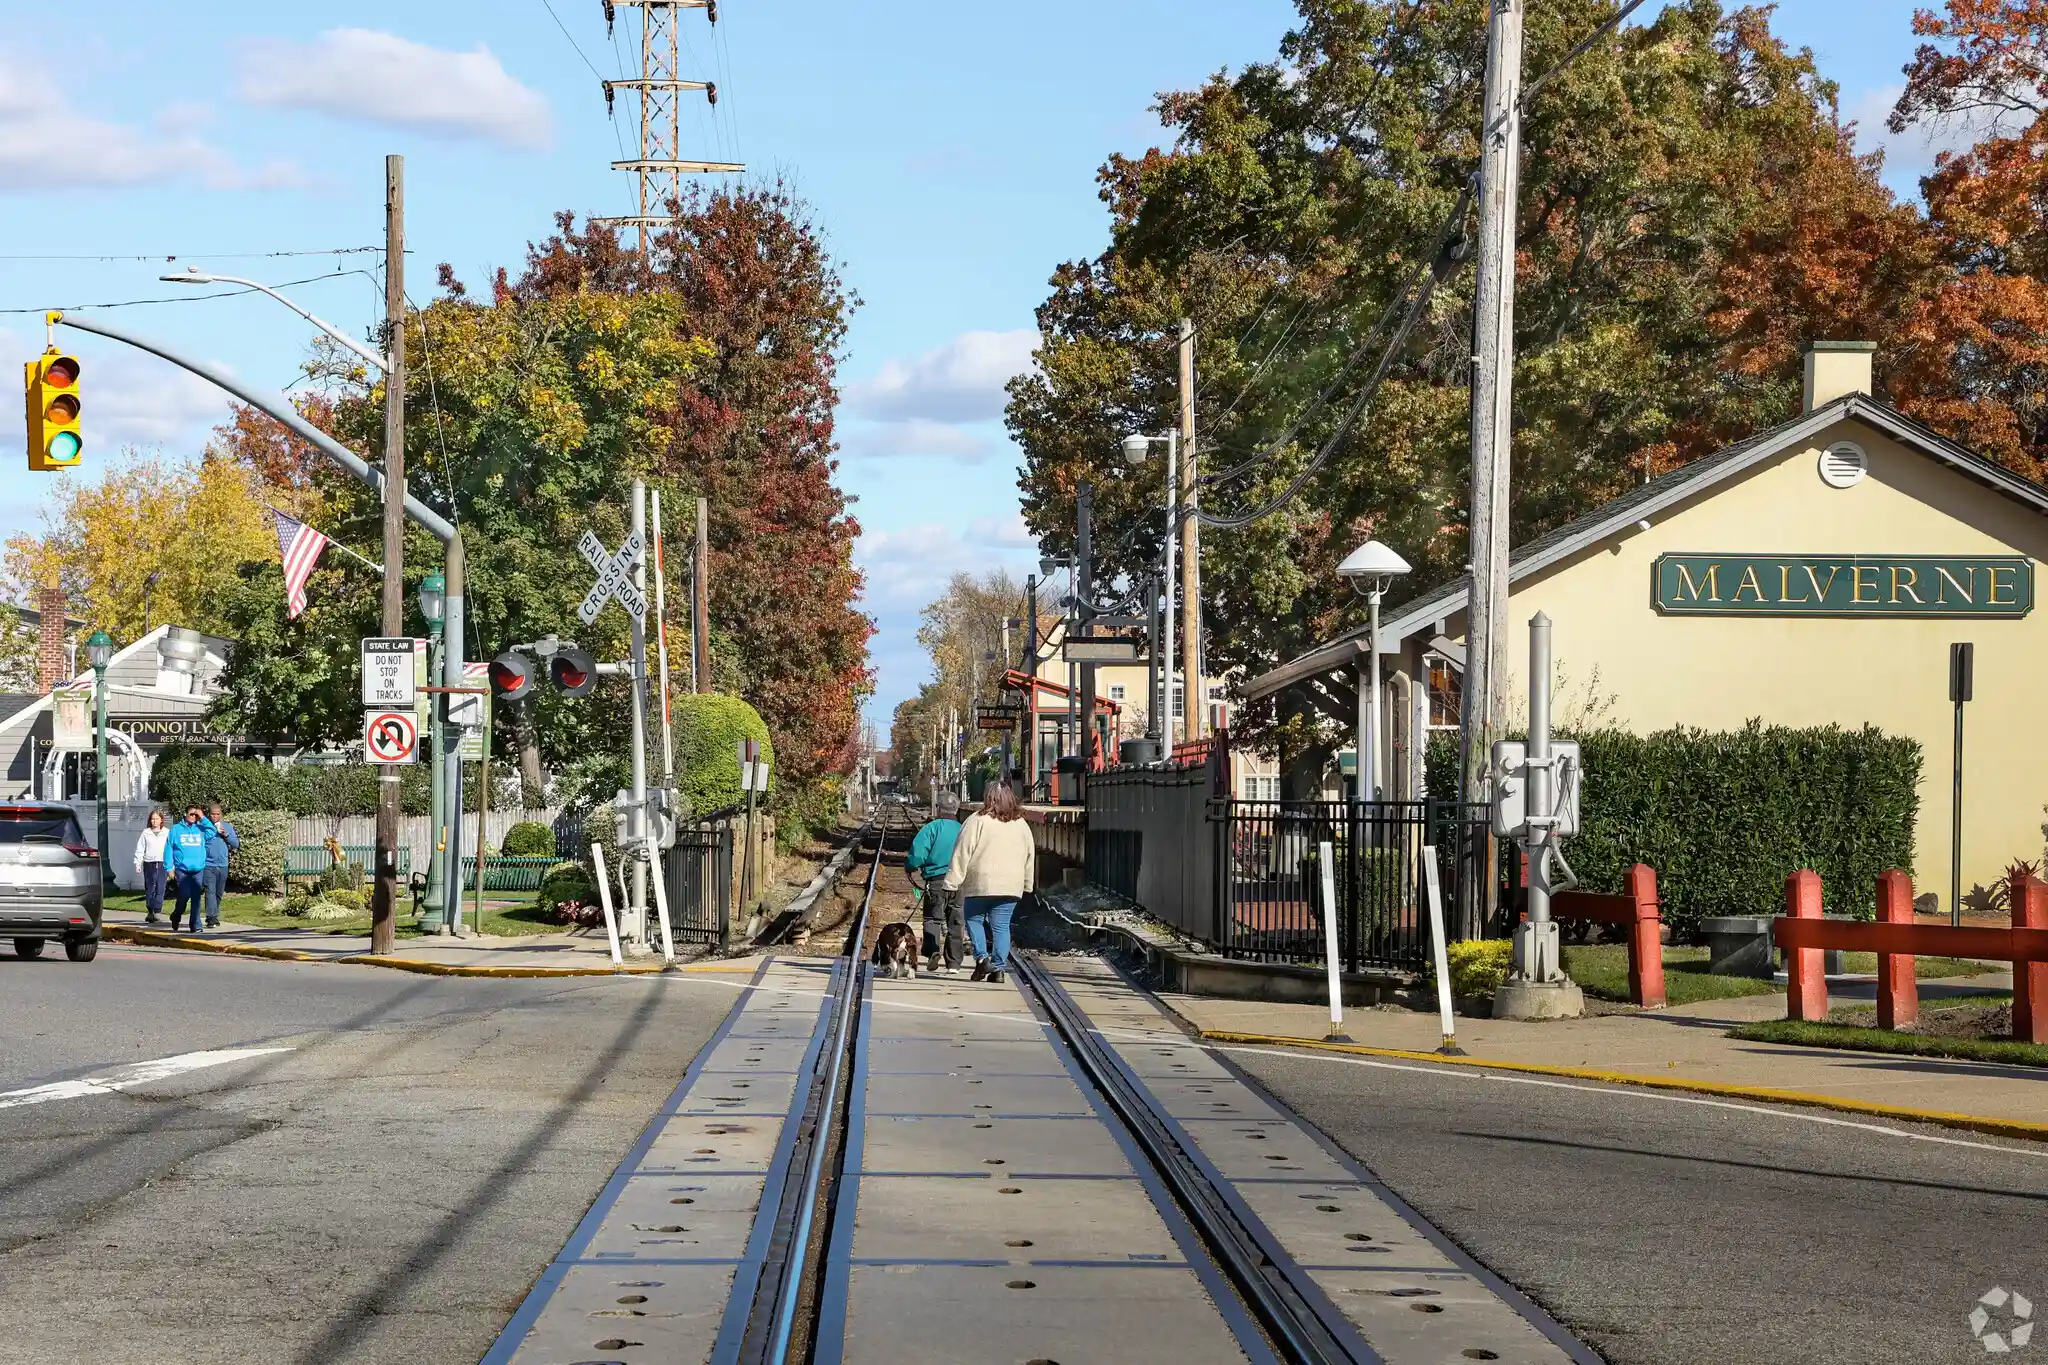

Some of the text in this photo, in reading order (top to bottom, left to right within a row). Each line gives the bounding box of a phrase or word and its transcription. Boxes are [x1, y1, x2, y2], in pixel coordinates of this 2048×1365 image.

[580, 535, 644, 616] RAIL ROAD
[583, 537, 640, 616] CROSSING
[1672, 563, 2019, 605] MALVERNE
[369, 642, 409, 650] STATE LAW
[375, 655, 402, 665] DO NOT
[380, 667, 398, 677] STOP
[384, 678, 395, 688] ON
[376, 690, 403, 700] TRACKS
[211, 735, 229, 743] AND
